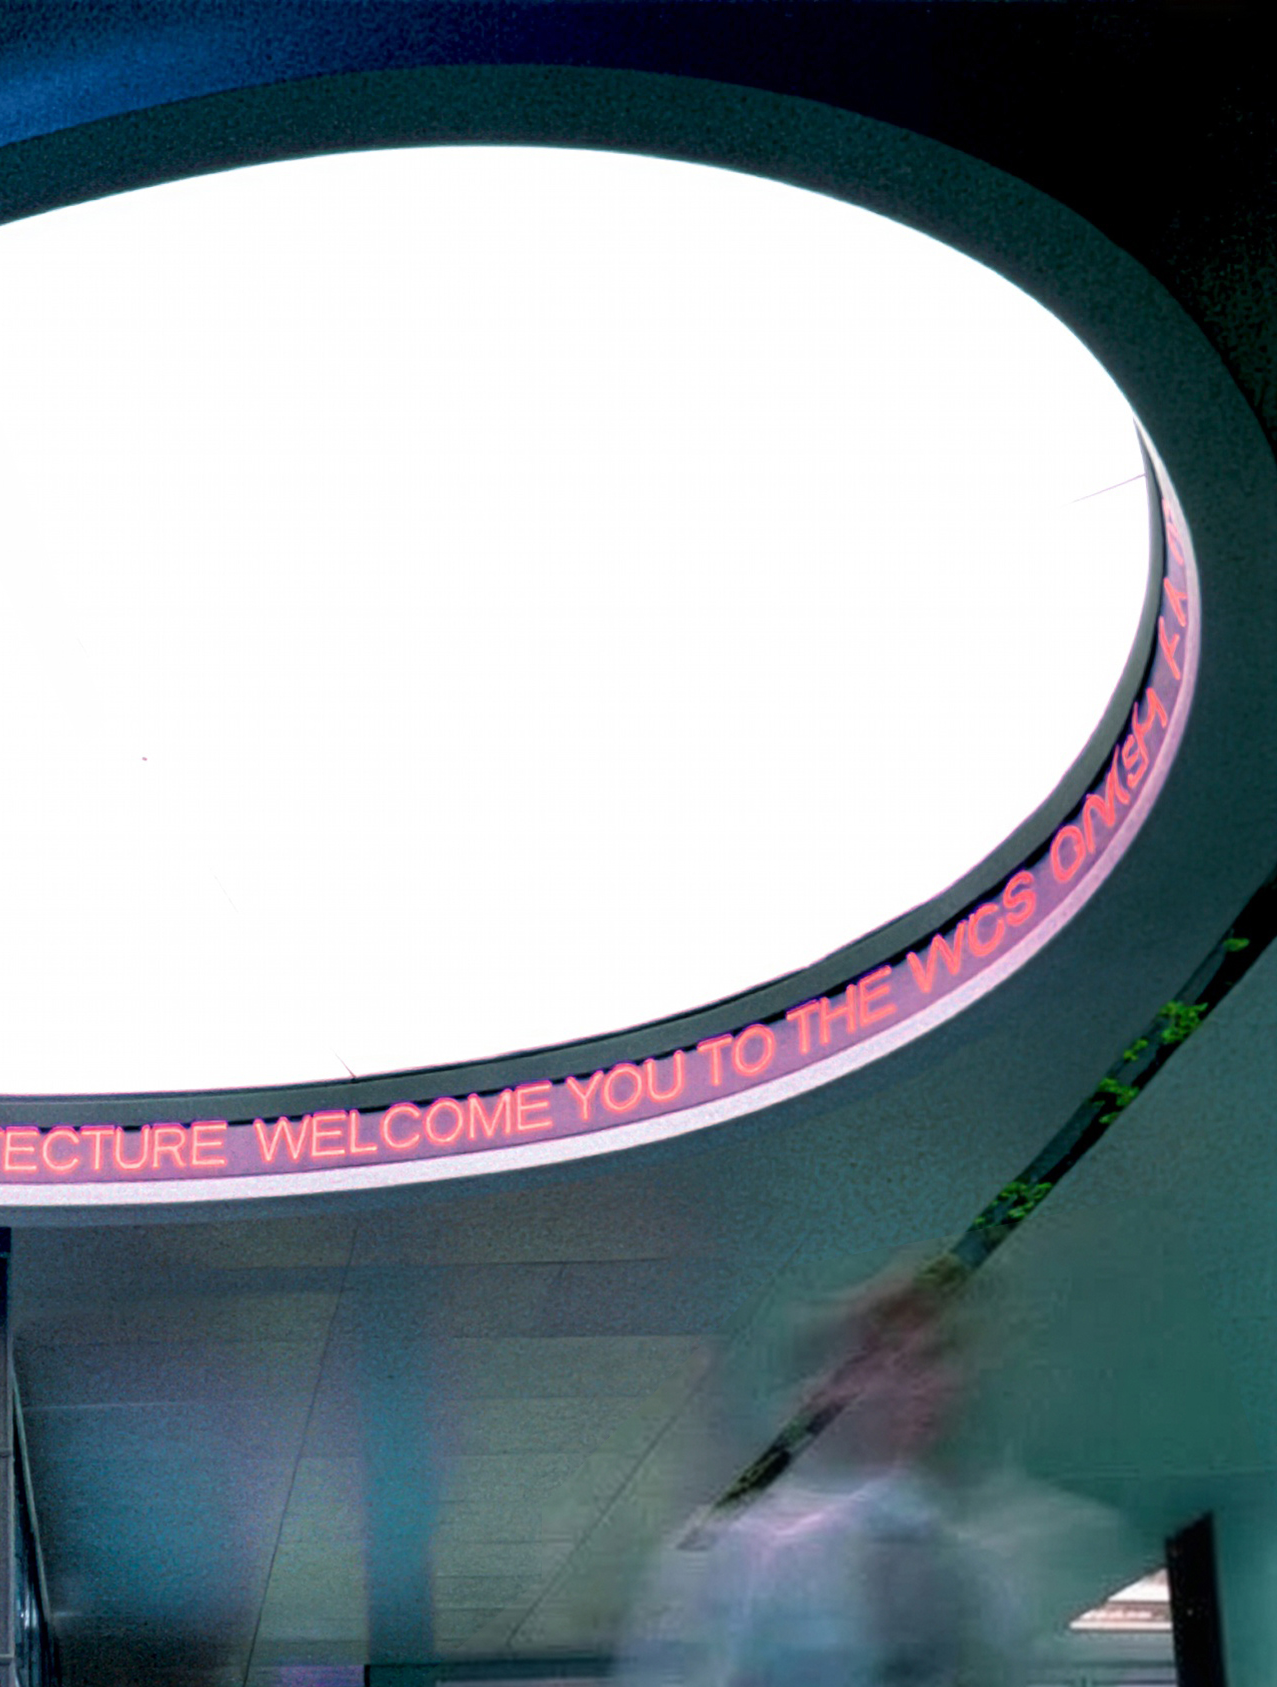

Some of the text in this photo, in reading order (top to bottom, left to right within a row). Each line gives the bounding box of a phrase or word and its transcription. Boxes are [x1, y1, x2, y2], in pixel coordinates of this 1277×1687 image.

[253, 1080, 553, 1163] WELCOME
[565, 1050, 685, 1119] YOU
[696, 1022, 776, 1085] TO
[785, 964, 899, 1055] THE
